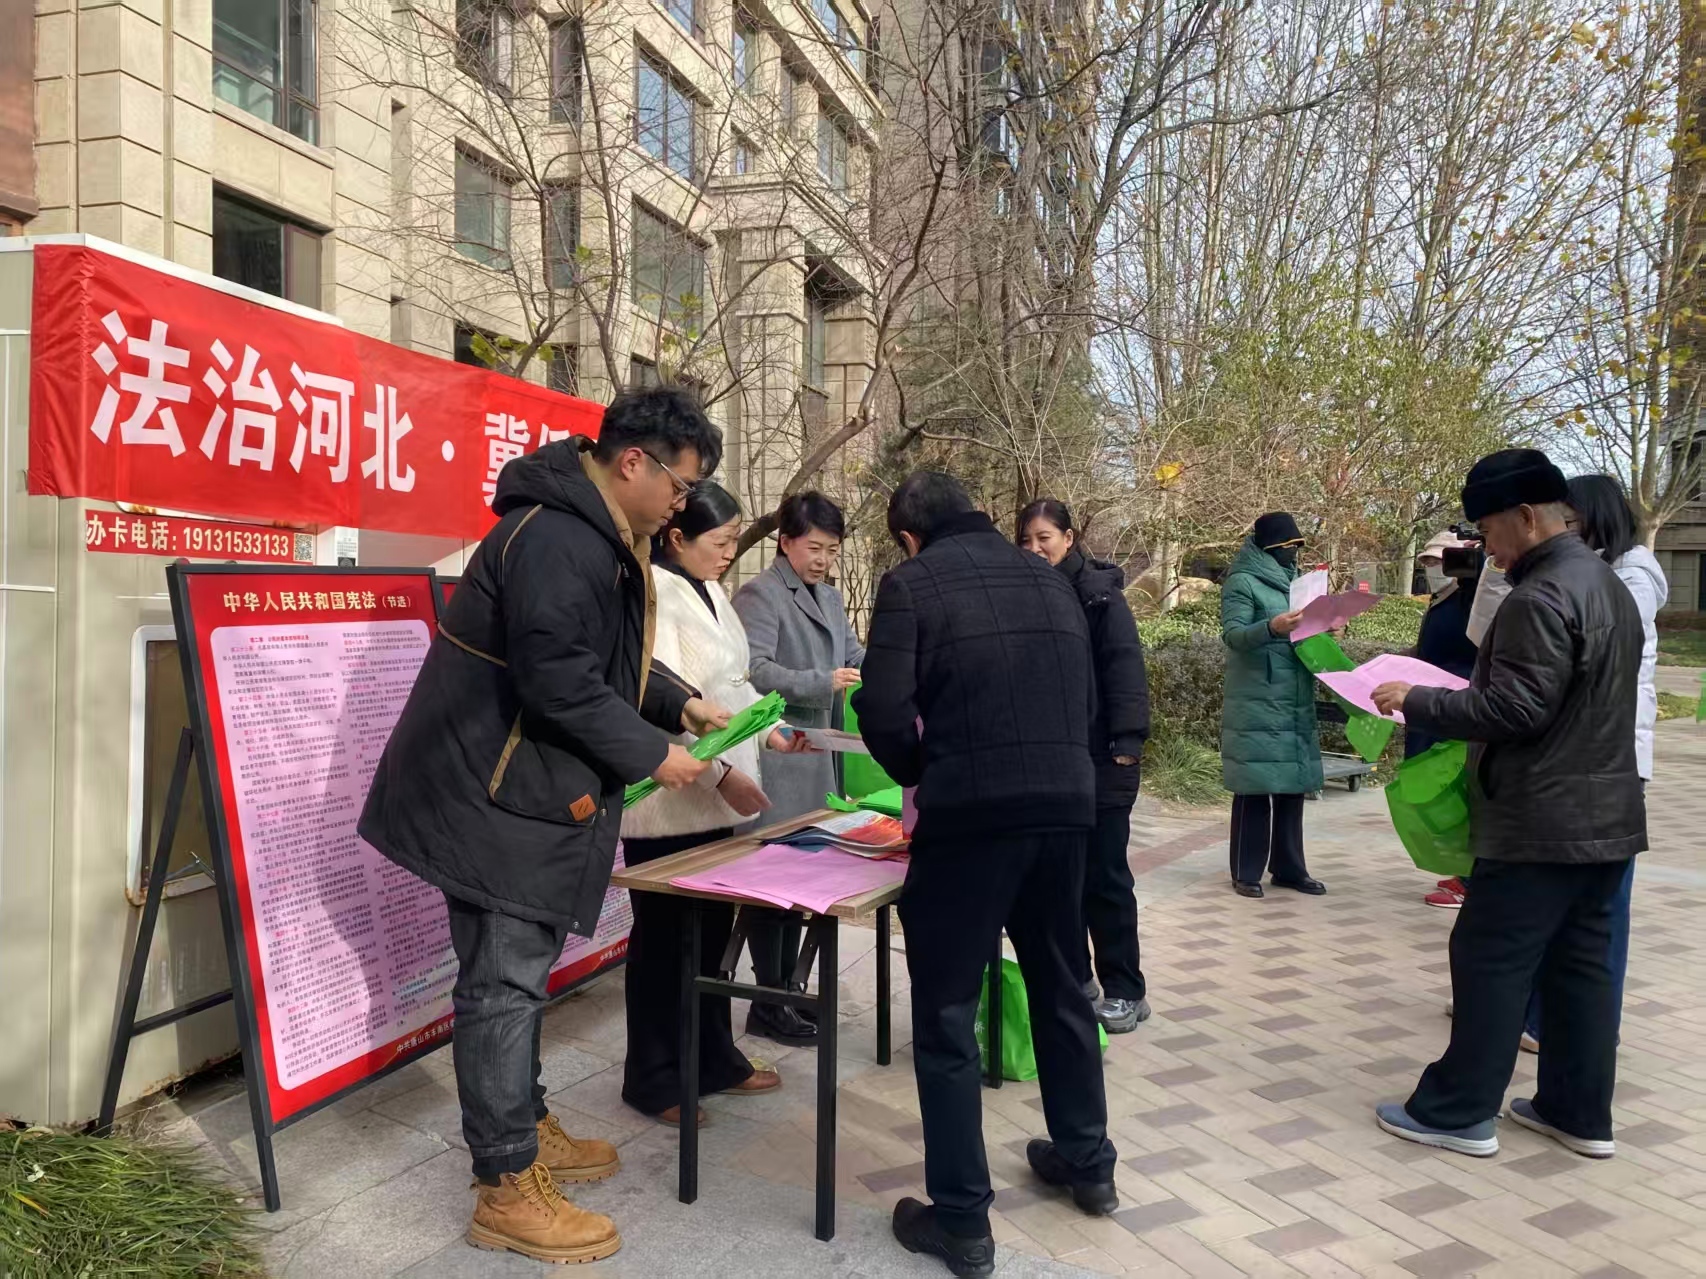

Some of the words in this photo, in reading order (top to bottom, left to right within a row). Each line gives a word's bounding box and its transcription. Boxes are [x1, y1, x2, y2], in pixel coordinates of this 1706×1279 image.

[90, 309, 572, 506] 法治河北·冀
